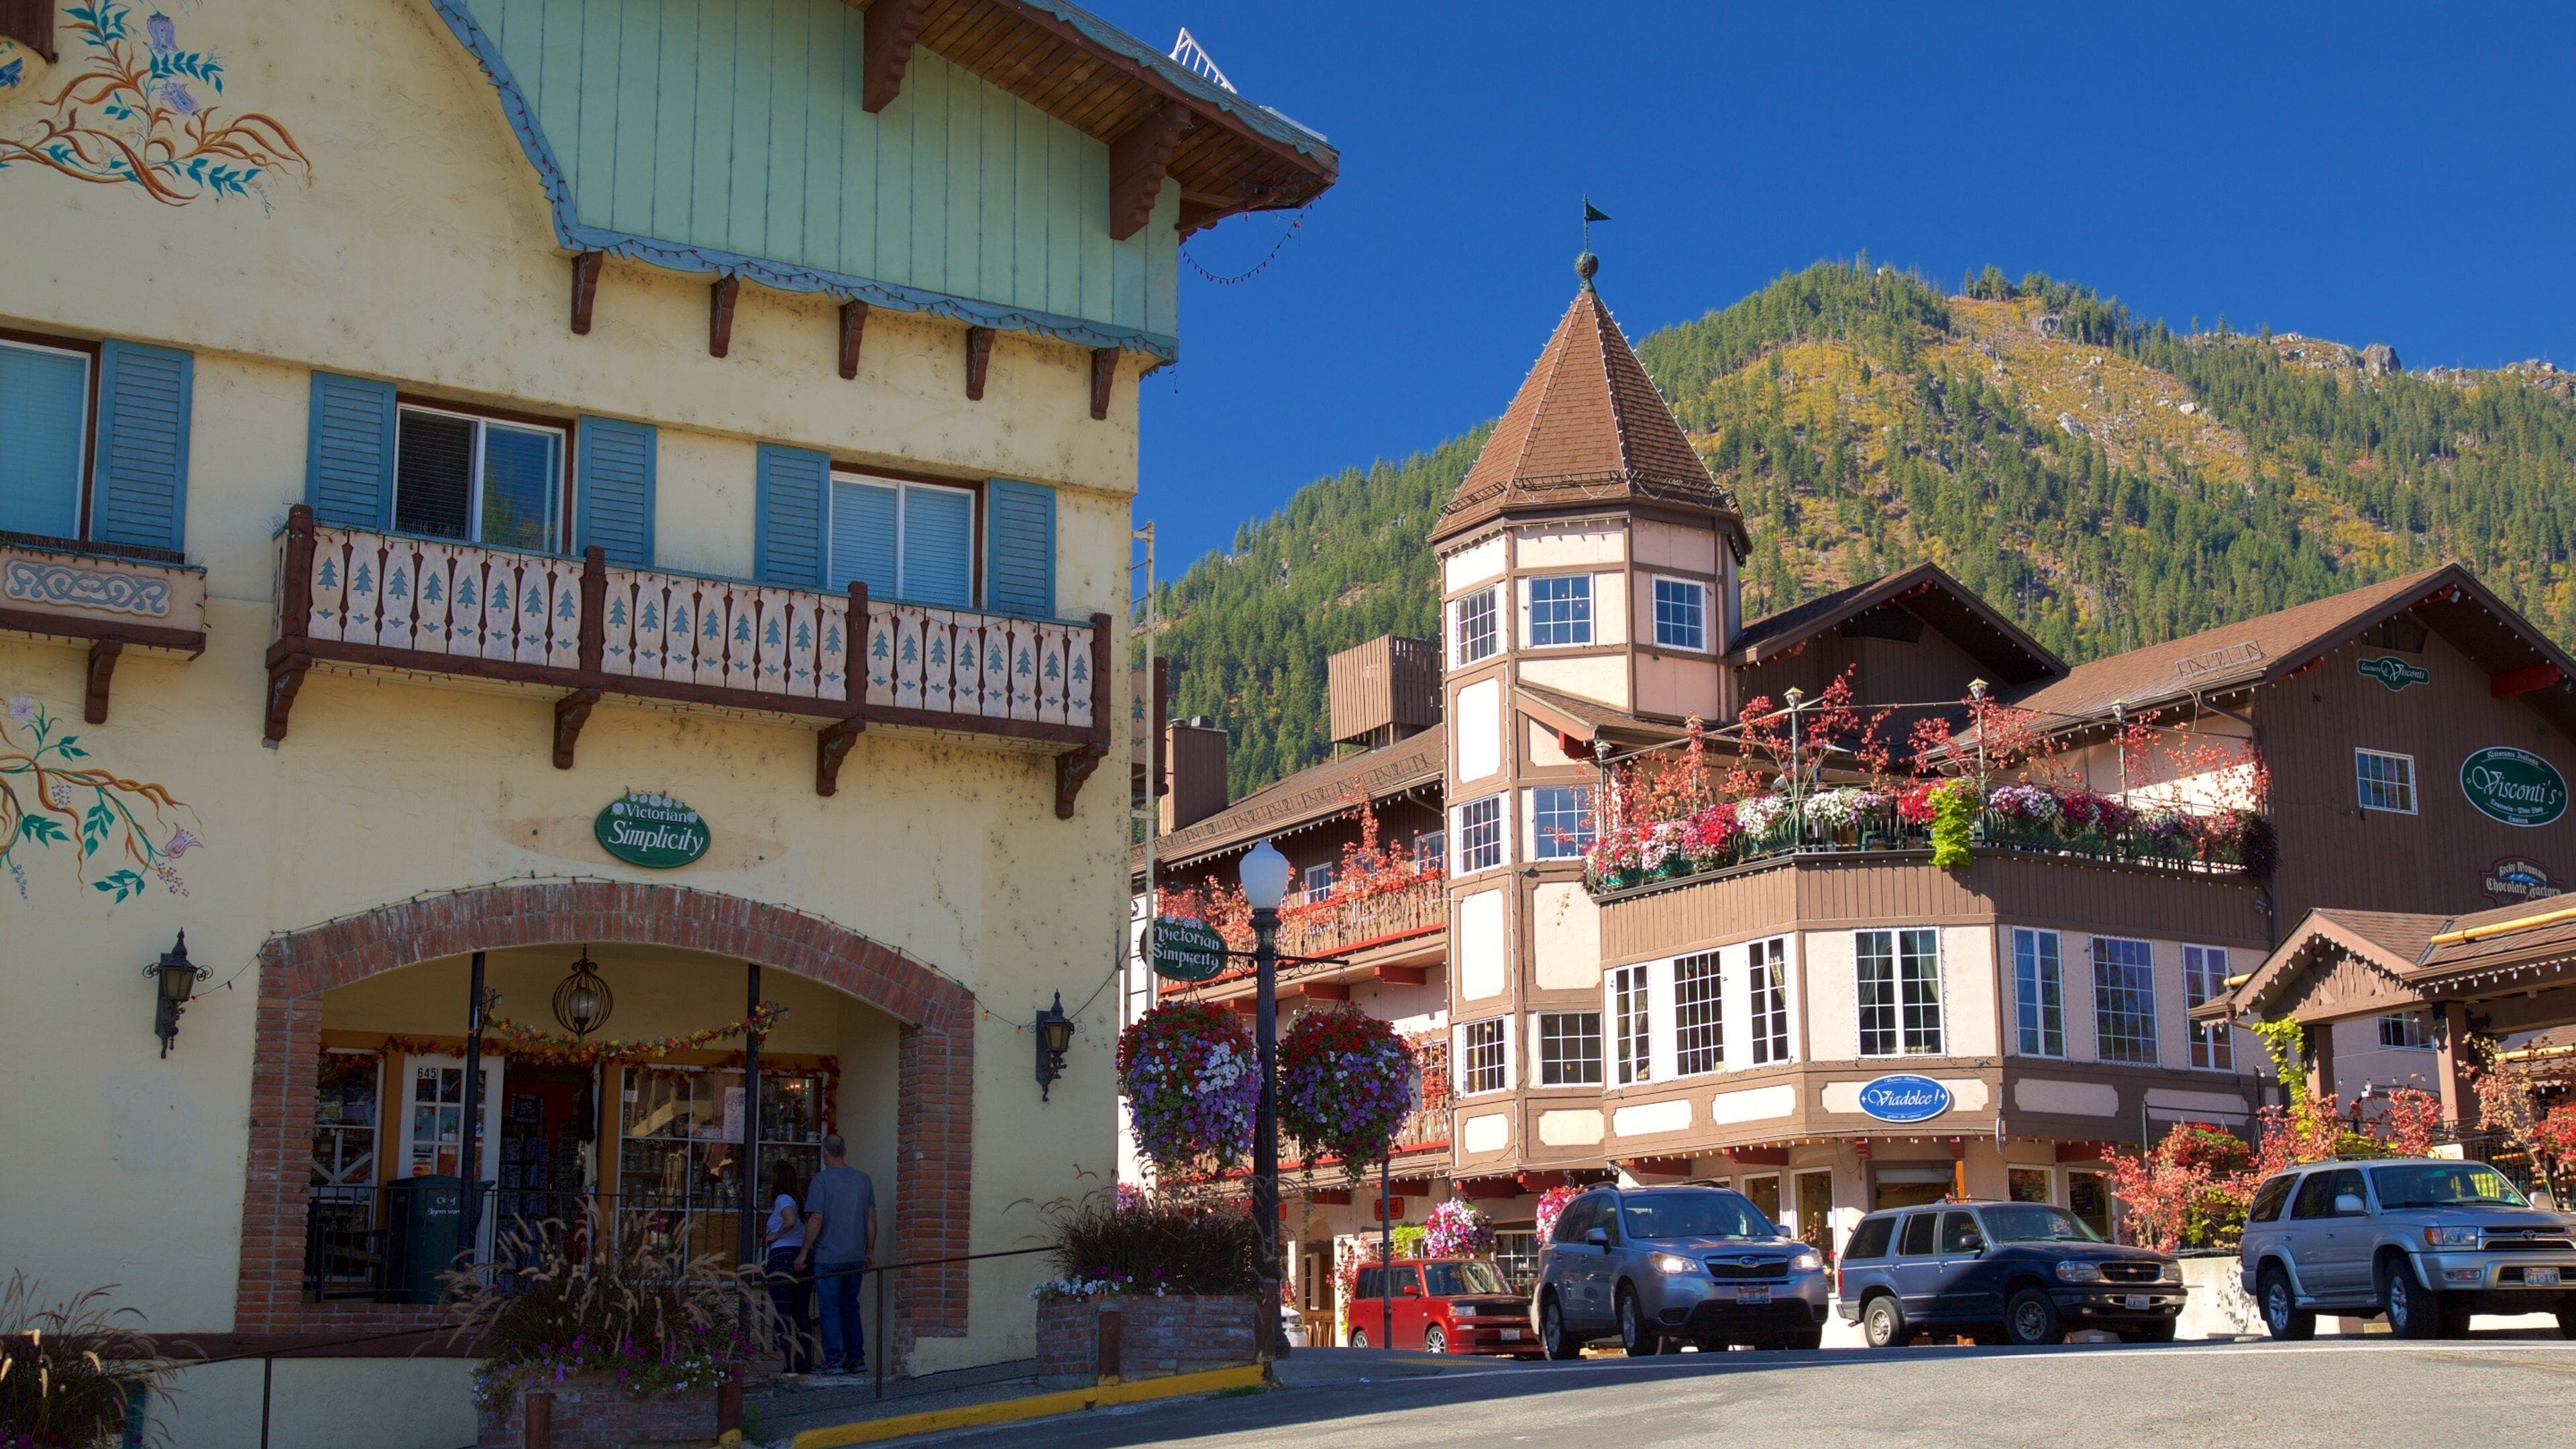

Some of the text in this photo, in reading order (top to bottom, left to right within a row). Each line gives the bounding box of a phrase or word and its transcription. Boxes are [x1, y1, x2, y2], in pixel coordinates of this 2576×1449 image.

[2381, 660, 2424, 681] Visconti
[2472, 766, 2557, 804] Visconti's
[625, 804, 687, 822] Victorian
[608, 820, 703, 856] Simplicity
[2499, 861, 2547, 882] Rocky Mountain
[2486, 877, 2527, 894] Chocolate
[1154, 926, 1219, 951] Victorian
[1152, 943, 1219, 973] Simplicity
[417, 1067, 436, 1078] 645
